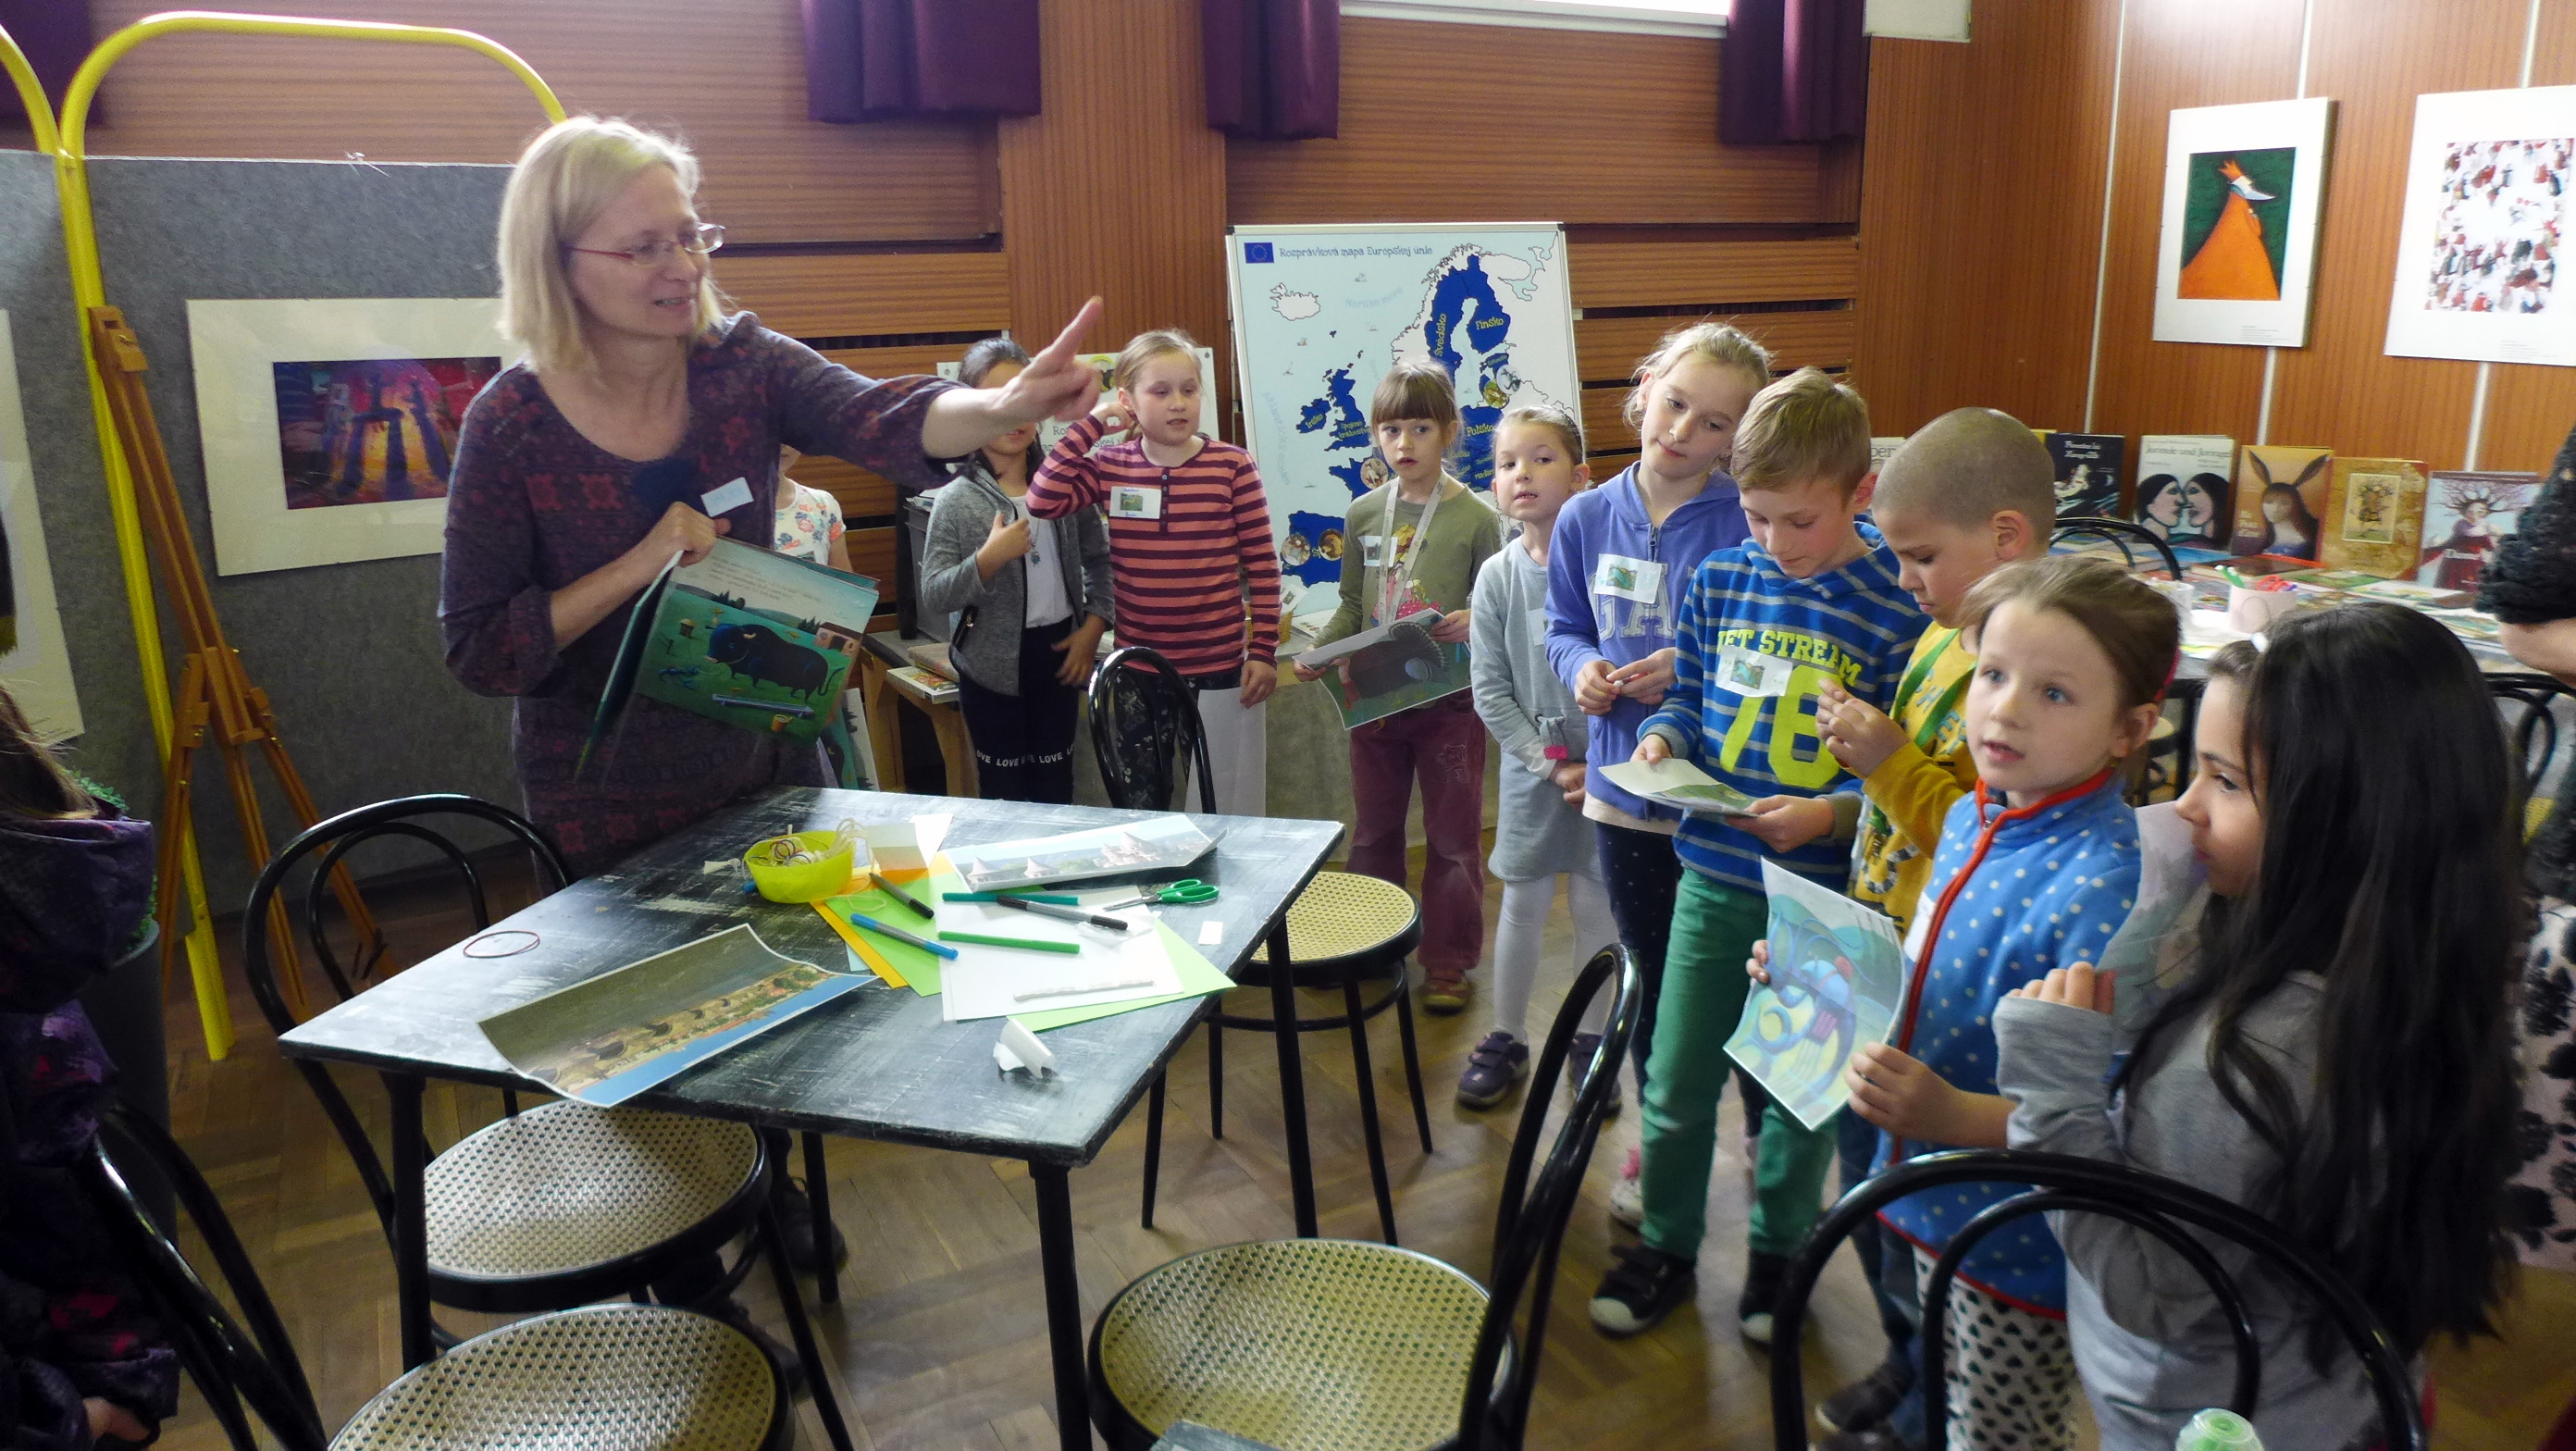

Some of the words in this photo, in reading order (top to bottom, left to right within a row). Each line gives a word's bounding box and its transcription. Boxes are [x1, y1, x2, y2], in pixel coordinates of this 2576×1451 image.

[1341, 248, 1365, 259] mapa
[1758, 629, 1863, 688] STREAM
[996, 758, 1019, 767] LOVE
[1038, 751, 1063, 763] LOVE
